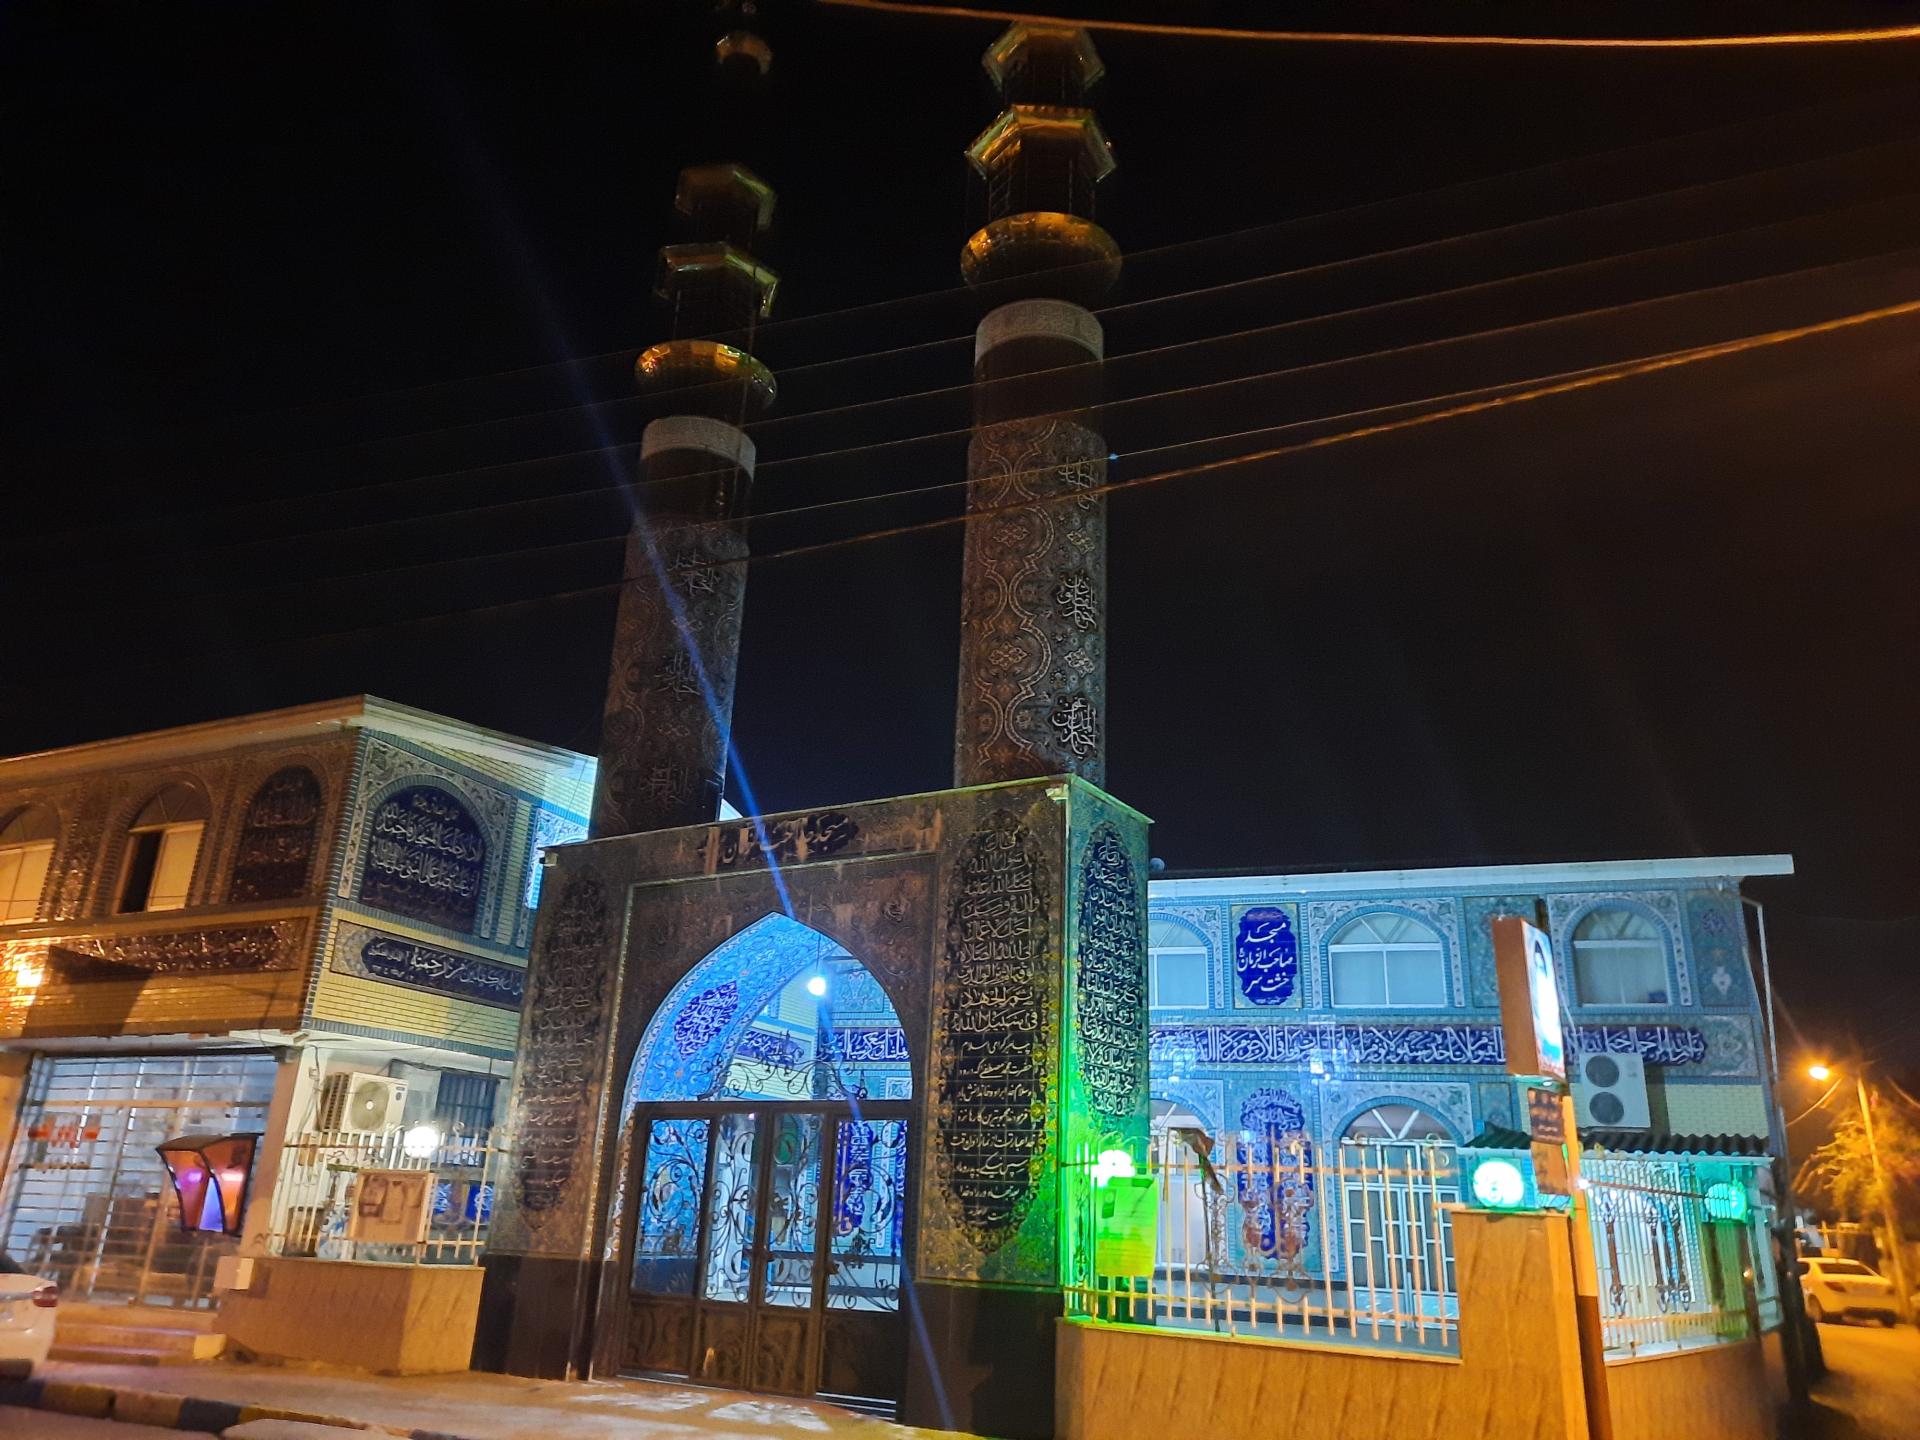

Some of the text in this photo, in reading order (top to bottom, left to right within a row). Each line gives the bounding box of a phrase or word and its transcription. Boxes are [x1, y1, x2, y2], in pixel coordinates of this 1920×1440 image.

[967, 851, 1029, 874] رسول الله
[1244, 922, 1287, 944] مسجد
[1237, 947, 1294, 973] صاحب الزمان
[1244, 972, 1290, 994] خشت سر
[952, 1010, 978, 1032] الله
